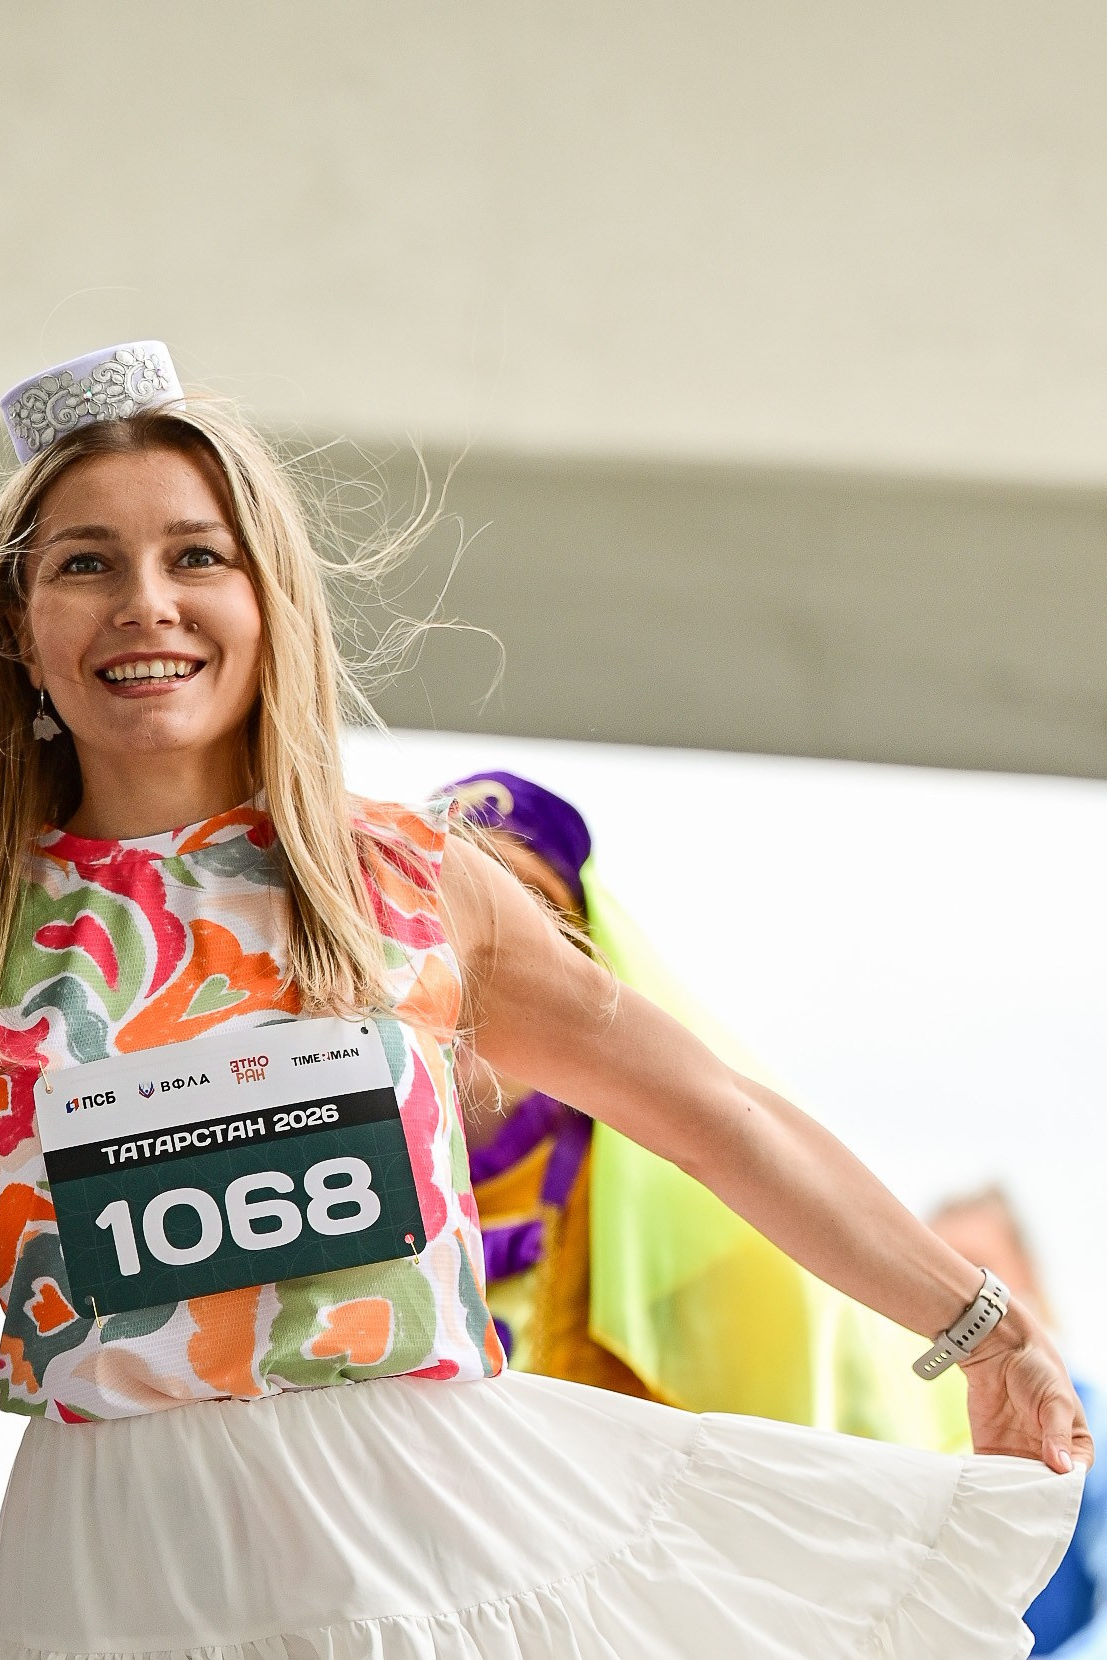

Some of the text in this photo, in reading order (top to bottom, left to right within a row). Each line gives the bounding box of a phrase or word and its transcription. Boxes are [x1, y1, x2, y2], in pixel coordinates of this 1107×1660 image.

[229, 1055, 270, 1074] ЭТНО
[160, 1073, 211, 1093] ВФЛА
[236, 1067, 267, 1085] РАН
[82, 1090, 117, 1110] ПСБ
[101, 1104, 340, 1165] ТАТАРСТАН 2026
[95, 1156, 382, 1277] 1068
